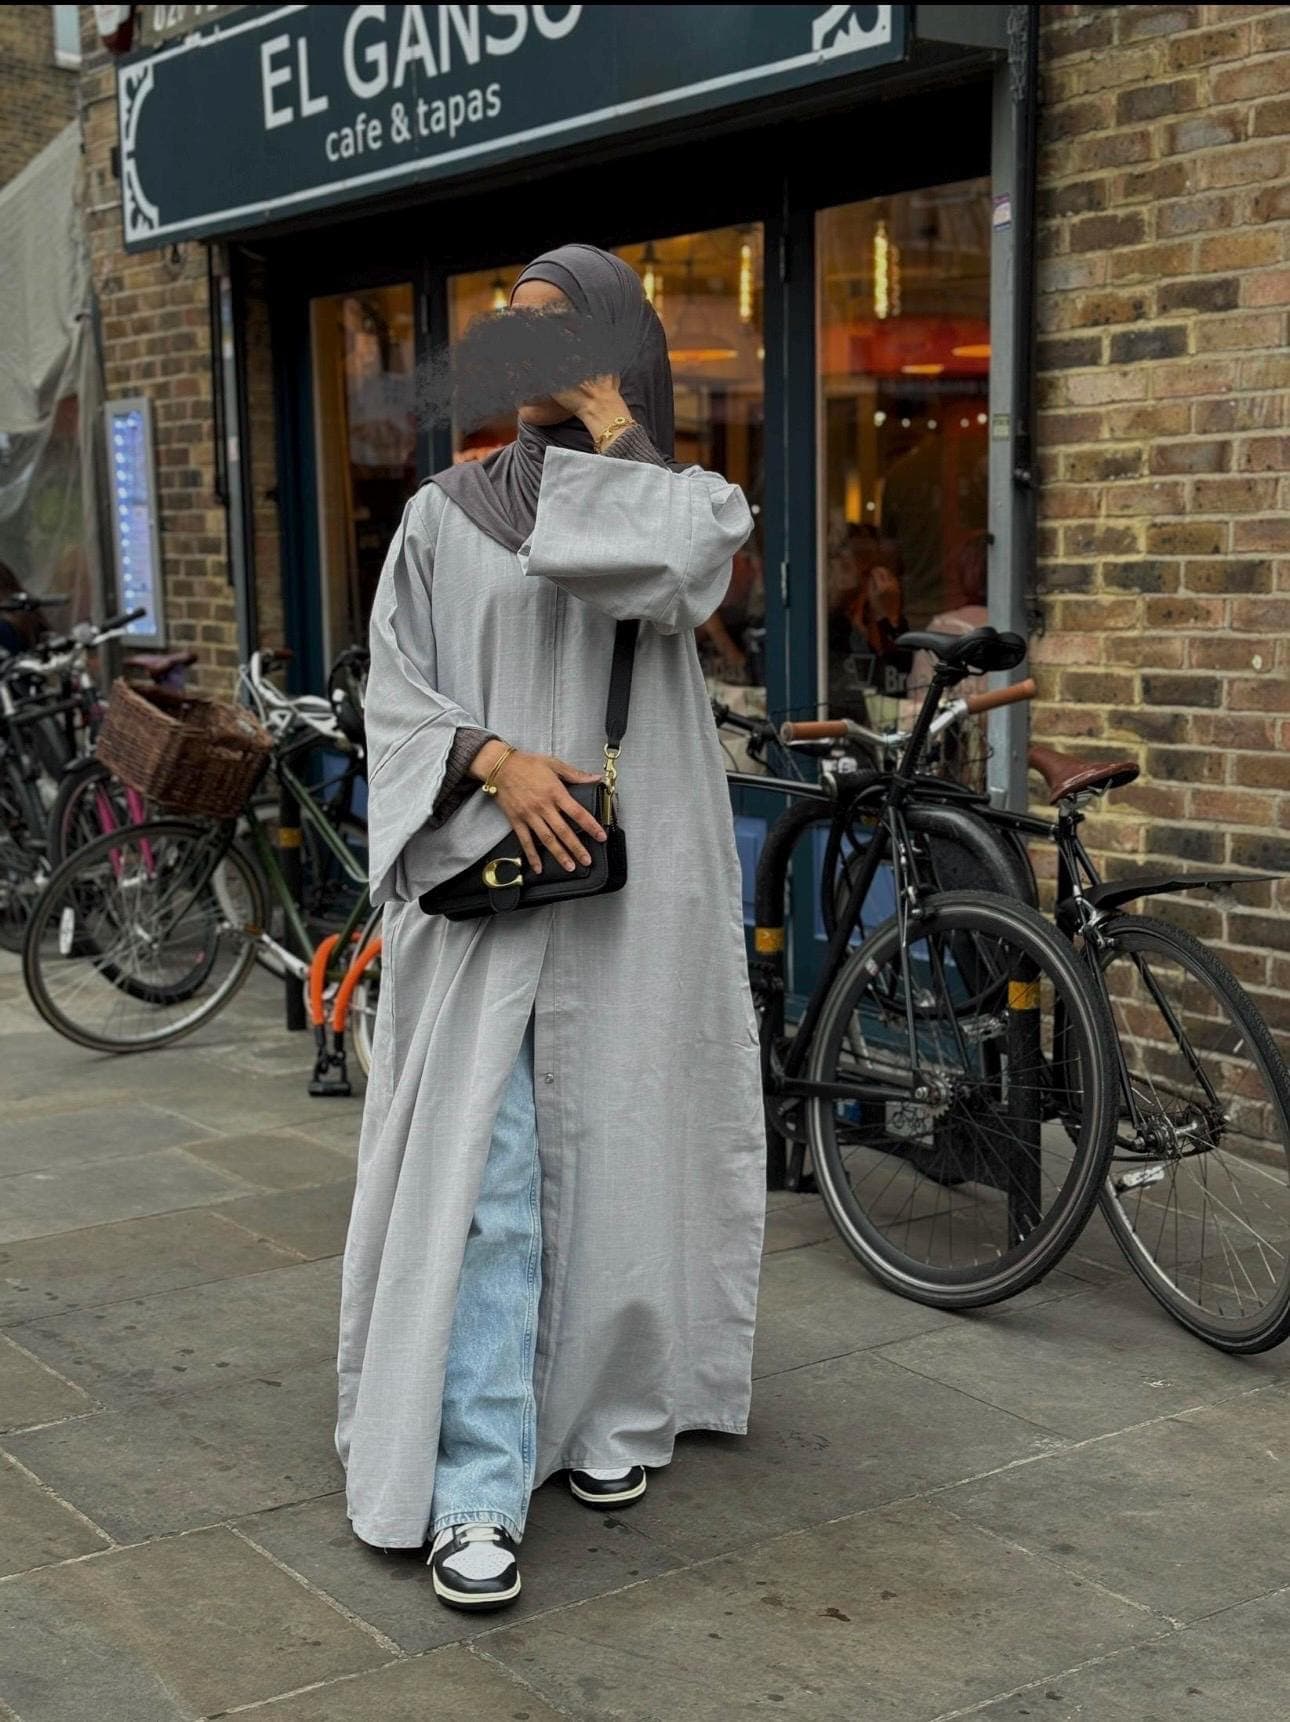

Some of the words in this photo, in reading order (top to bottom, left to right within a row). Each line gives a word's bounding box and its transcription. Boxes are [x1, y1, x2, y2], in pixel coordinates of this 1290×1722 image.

[261, 33, 329, 130] EL
[325, 112, 383, 162] cafe
[391, 101, 411, 144] &
[417, 82, 501, 138] tapas
